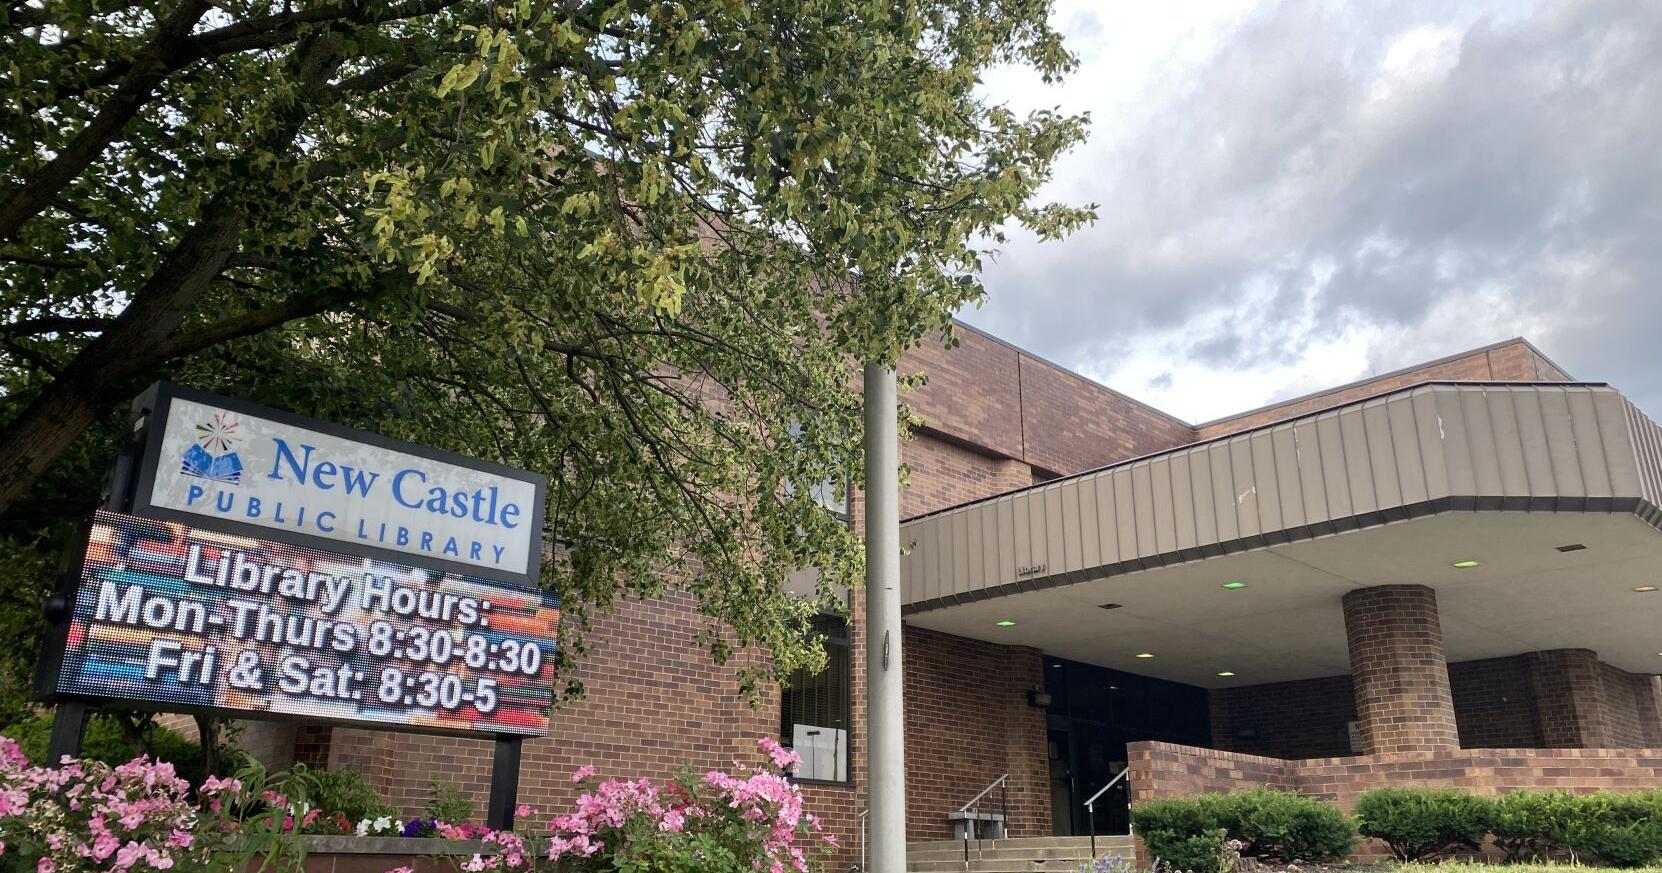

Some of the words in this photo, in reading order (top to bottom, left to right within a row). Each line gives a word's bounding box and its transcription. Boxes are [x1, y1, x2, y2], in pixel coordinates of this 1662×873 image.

[267, 438, 380, 498] New
[392, 469, 520, 528] Castle
[187, 485, 336, 532] PUBLIC
[358, 519, 504, 564] LIBRARY
[185, 545, 350, 613] Library
[361, 573, 491, 626] Hours:
[95, 580, 356, 651] Mon-Thurs
[369, 620, 541, 675] 8:30-8:30
[145, 638, 217, 685] Fri
[229, 650, 264, 690] &
[279, 654, 365, 700] Sat:
[379, 668, 498, 712] 8:30-5
